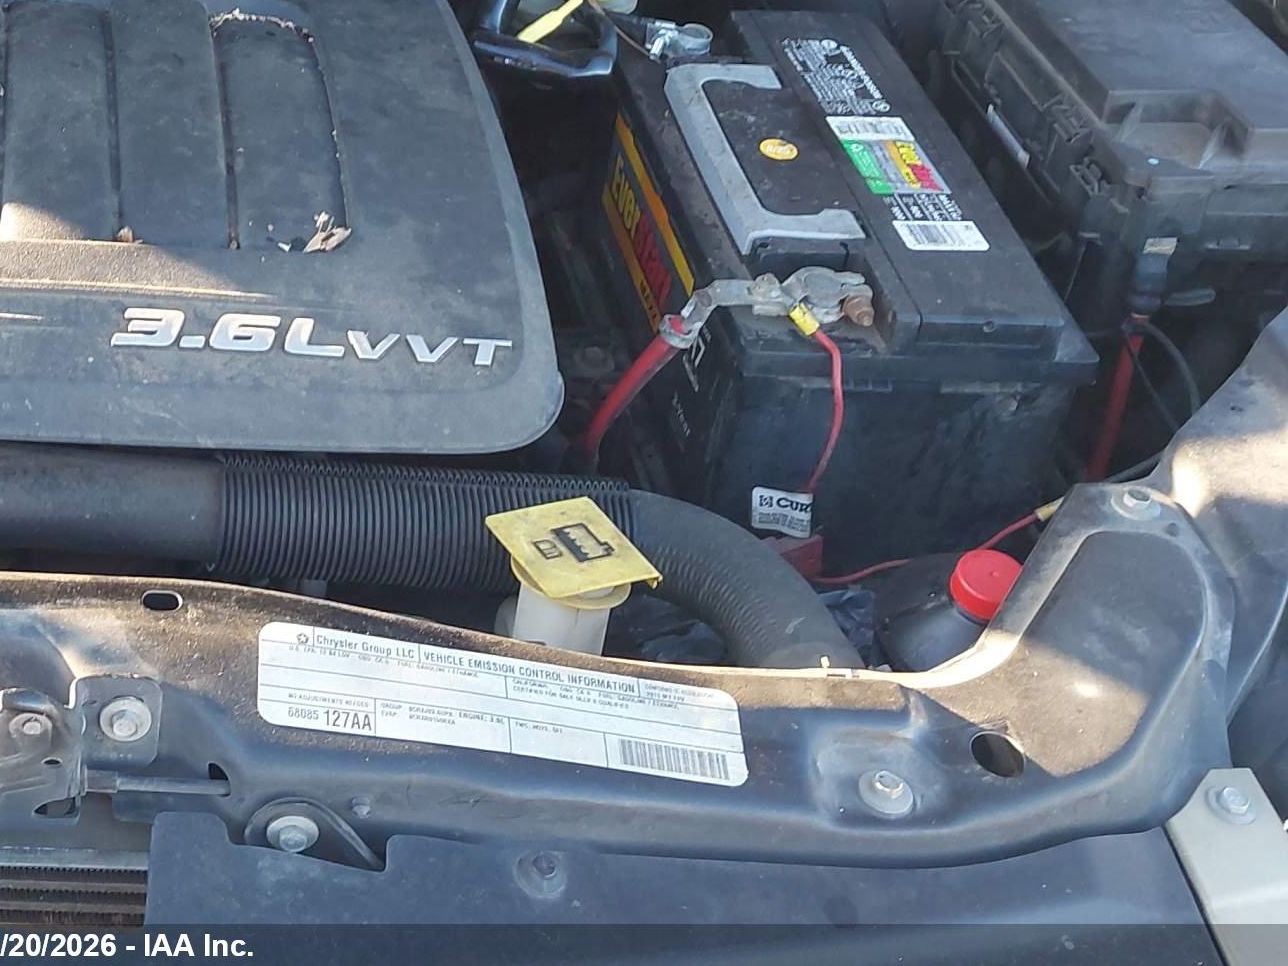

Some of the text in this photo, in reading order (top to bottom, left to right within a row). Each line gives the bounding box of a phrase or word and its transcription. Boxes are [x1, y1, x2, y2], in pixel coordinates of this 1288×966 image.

[347, 329, 513, 366] VVT
[776, 497, 814, 514] CUR
[316, 634, 358, 650] Chrysler
[361, 642, 392, 657] Group
[396, 648, 415, 659] LLC
[423, 651, 465, 667] VEHICLE
[468, 659, 515, 675] EMISSION
[519, 667, 562, 683] CONTROL
[567, 674, 636, 693] INFORMATION
[287, 706, 373, 731] 68085 127AA
